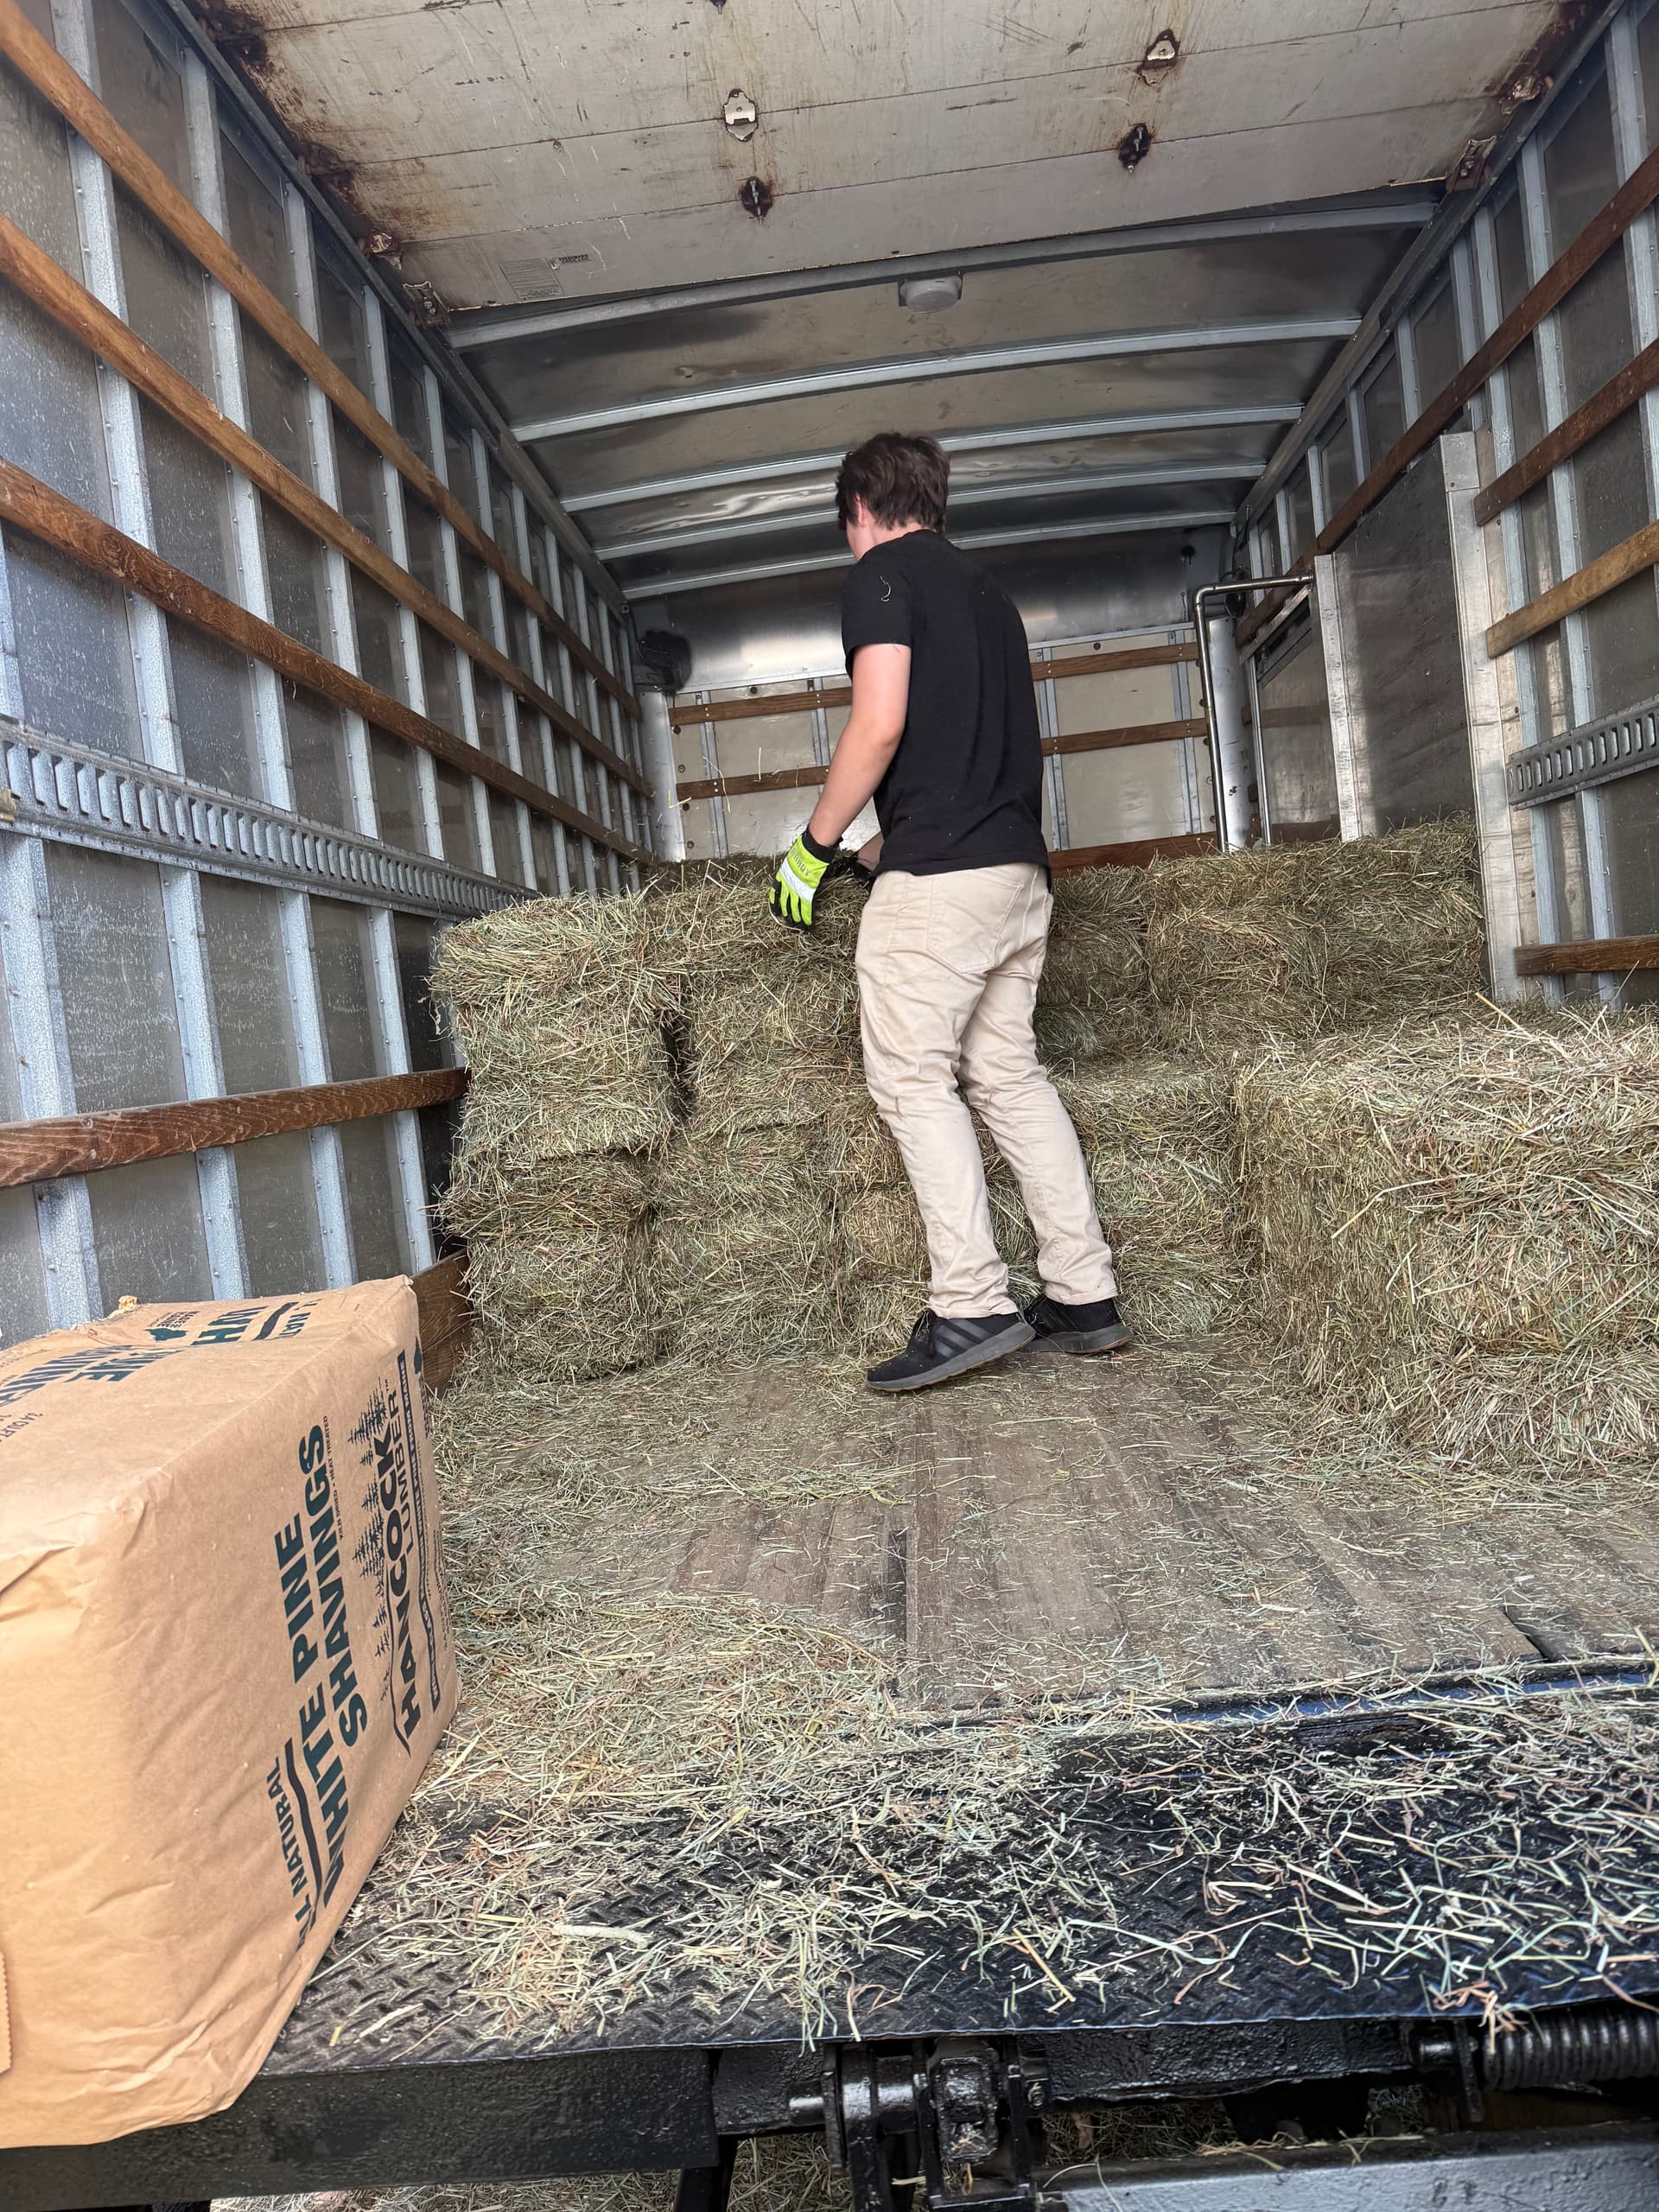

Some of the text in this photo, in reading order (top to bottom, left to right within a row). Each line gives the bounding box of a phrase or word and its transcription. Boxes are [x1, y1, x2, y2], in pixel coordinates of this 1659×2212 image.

[400, 1359, 410, 1408] MAINE
[322, 1414, 332, 1454] TREATED
[406, 1410, 415, 1452] FROM
[387, 1389, 414, 1556] LUMBER
[410, 1454, 419, 1487] PINE
[333, 1489, 341, 1517] DRIED
[414, 1490, 423, 1535] WHITE
[298, 1424, 367, 1748] SHAVINGS
[373, 1421, 422, 1738] HANCOCK
[275, 1512, 349, 1908] WHITE PINE
[266, 1756, 308, 1897] NATURAL
